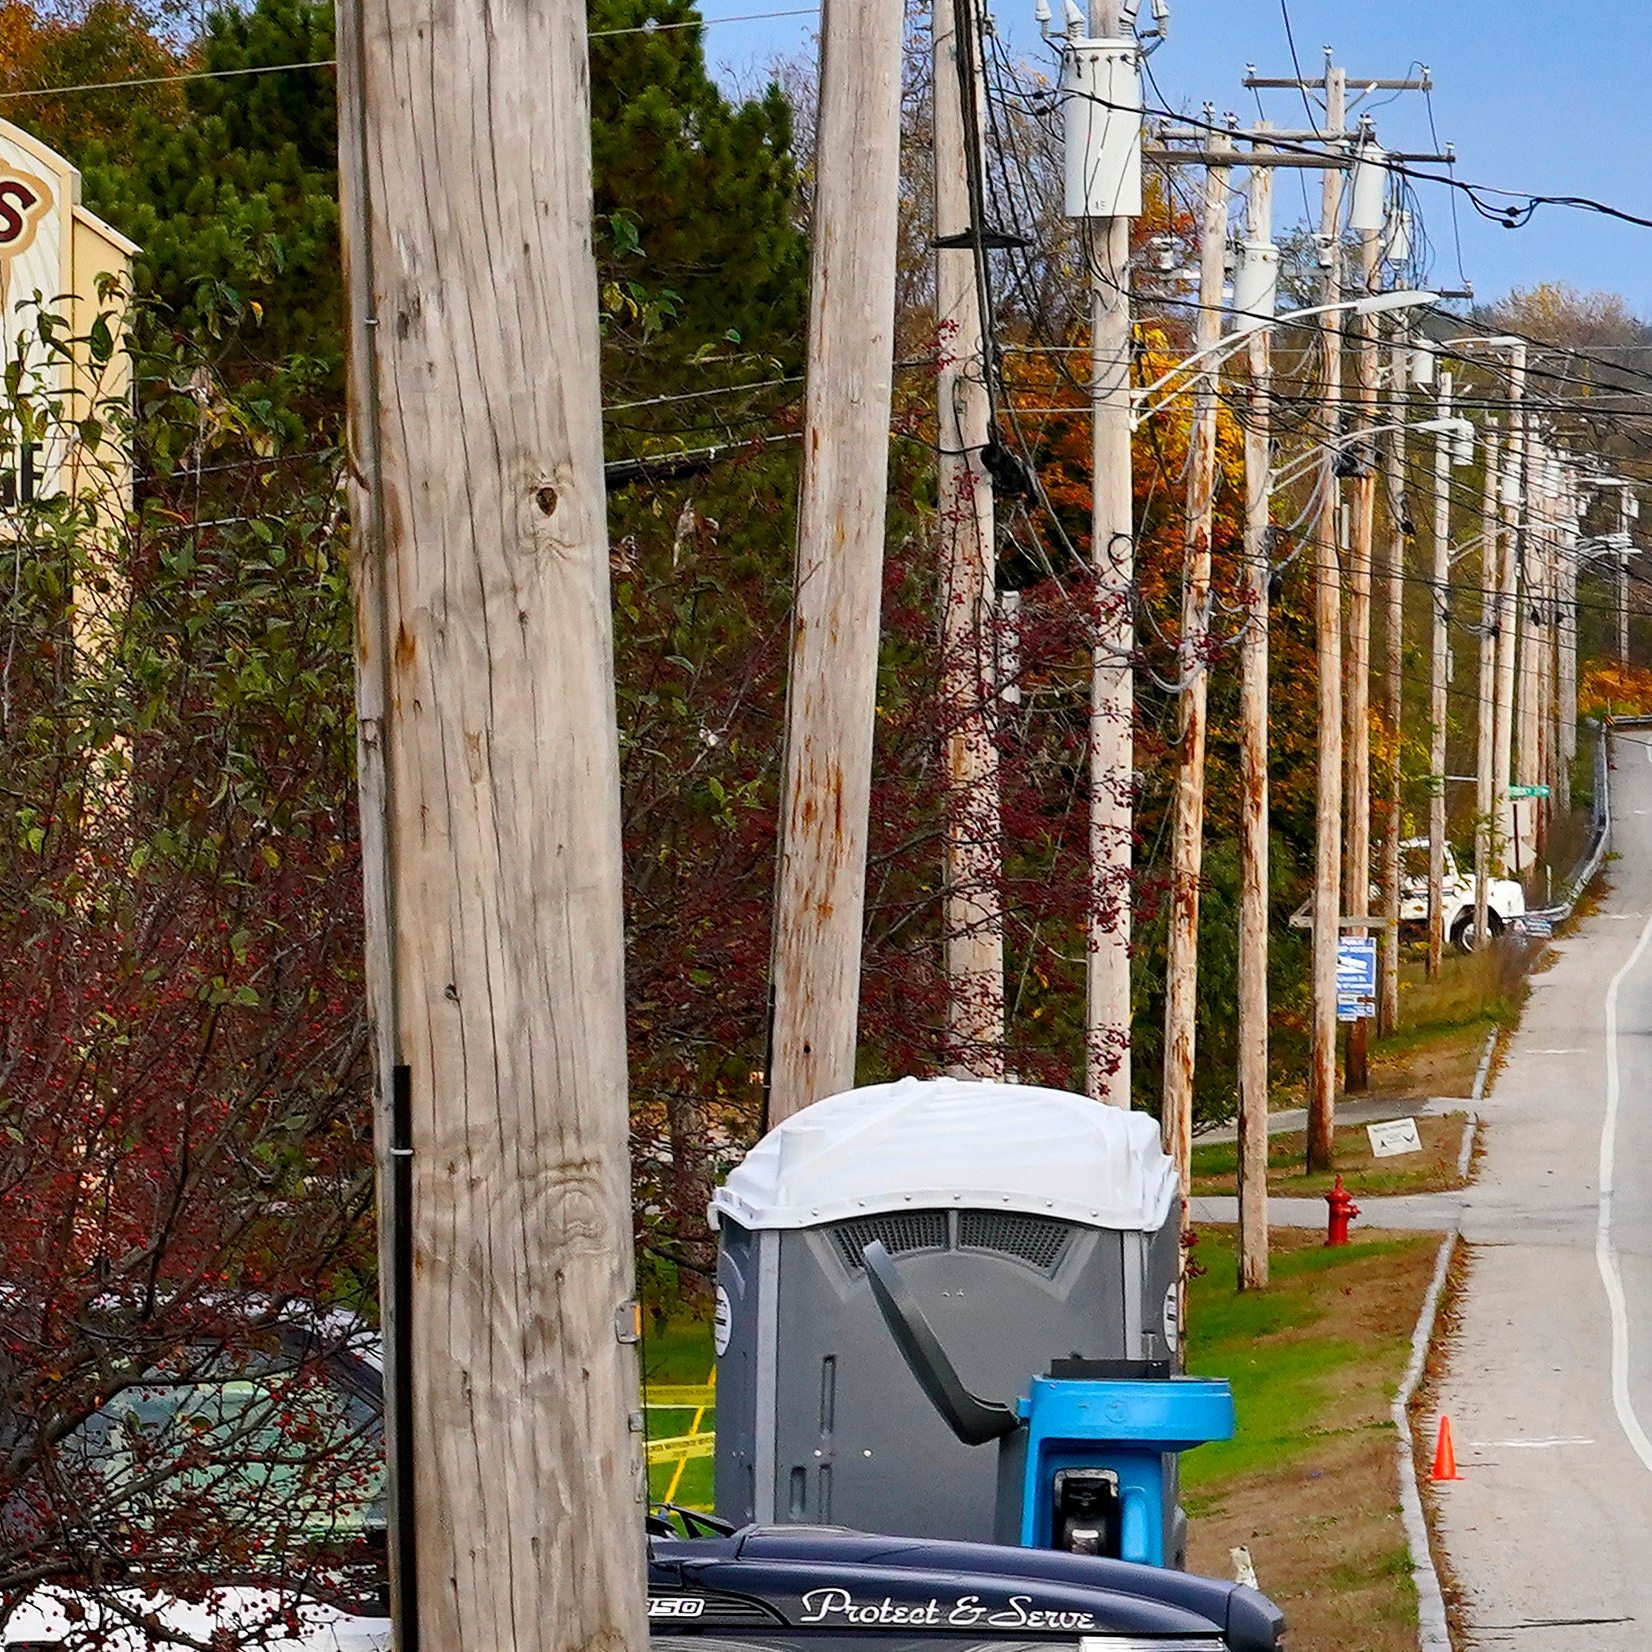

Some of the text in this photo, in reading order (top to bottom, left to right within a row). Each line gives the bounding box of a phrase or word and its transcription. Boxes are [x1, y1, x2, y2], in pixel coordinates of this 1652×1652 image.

[802, 1588, 1095, 1629] Protect & Serve
